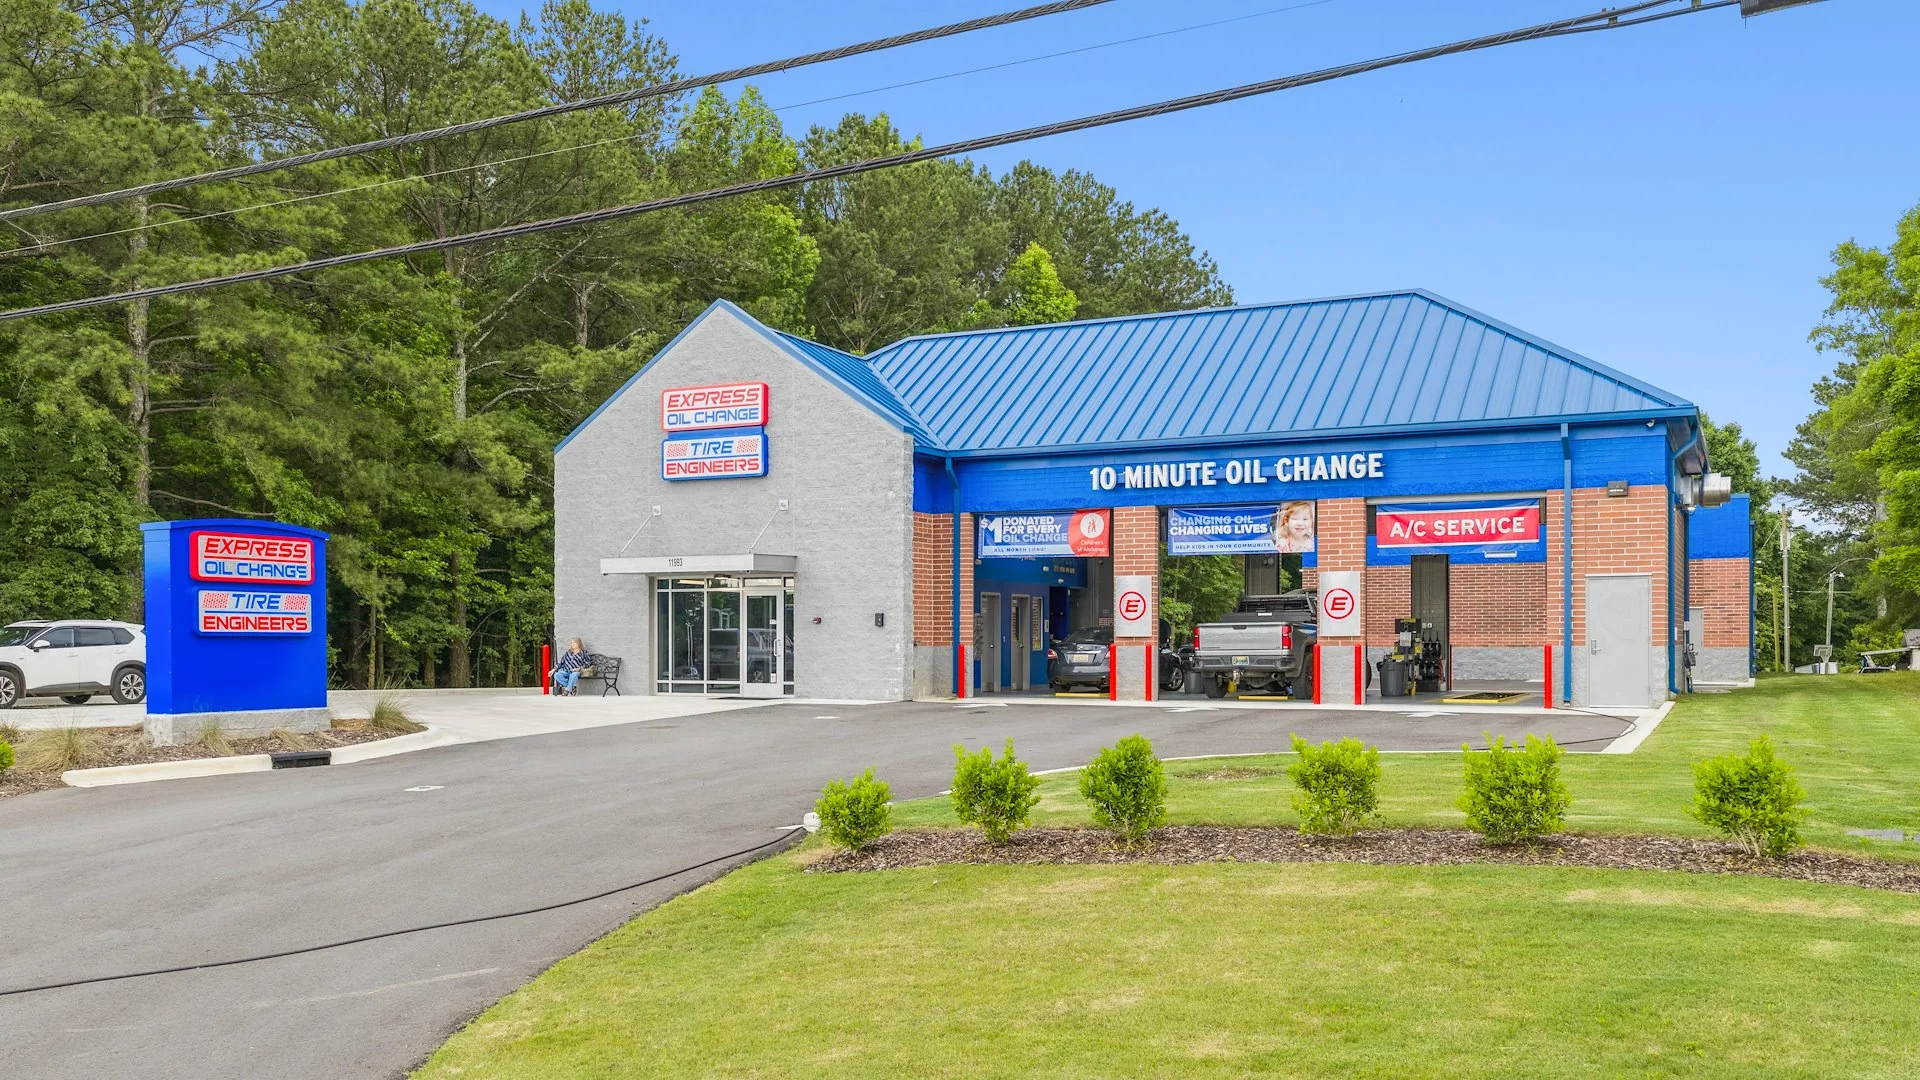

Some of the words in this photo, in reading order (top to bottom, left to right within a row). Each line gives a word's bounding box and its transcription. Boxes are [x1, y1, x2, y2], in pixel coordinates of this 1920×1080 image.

[667, 388, 760, 408] EXPRESS
[667, 412, 691, 425] OIL
[694, 407, 759, 423] CHANGE
[691, 440, 734, 456] TIRE
[666, 458, 760, 475] ENGINEERS
[1089, 466, 1117, 490] 10
[1124, 461, 1217, 489] MINUTE
[1225, 459, 1268, 485] OIL
[1275, 452, 1384, 482] CHANGE
[1003, 516, 1054, 525] DONATED
[1170, 515, 1232, 526] CHANGING
[1234, 515, 1254, 524] OIL
[1389, 520, 1427, 538] A/C
[1433, 516, 1526, 536] SERVICE
[1003, 525, 1024, 535] FOR
[1026, 524, 1062, 534] EVERY
[1003, 533, 1021, 543] OIL
[1022, 533, 1067, 542] CHANGE
[1170, 525, 1232, 535] CHANGING
[1234, 524, 1268, 534] LIVES
[204, 538, 308, 558] EXPRESS
[204, 561, 233, 575] OIL
[236, 563, 307, 578] CHANGE
[232, 593, 282, 610] TIRE
[203, 616, 308, 631] ENGINEERS
